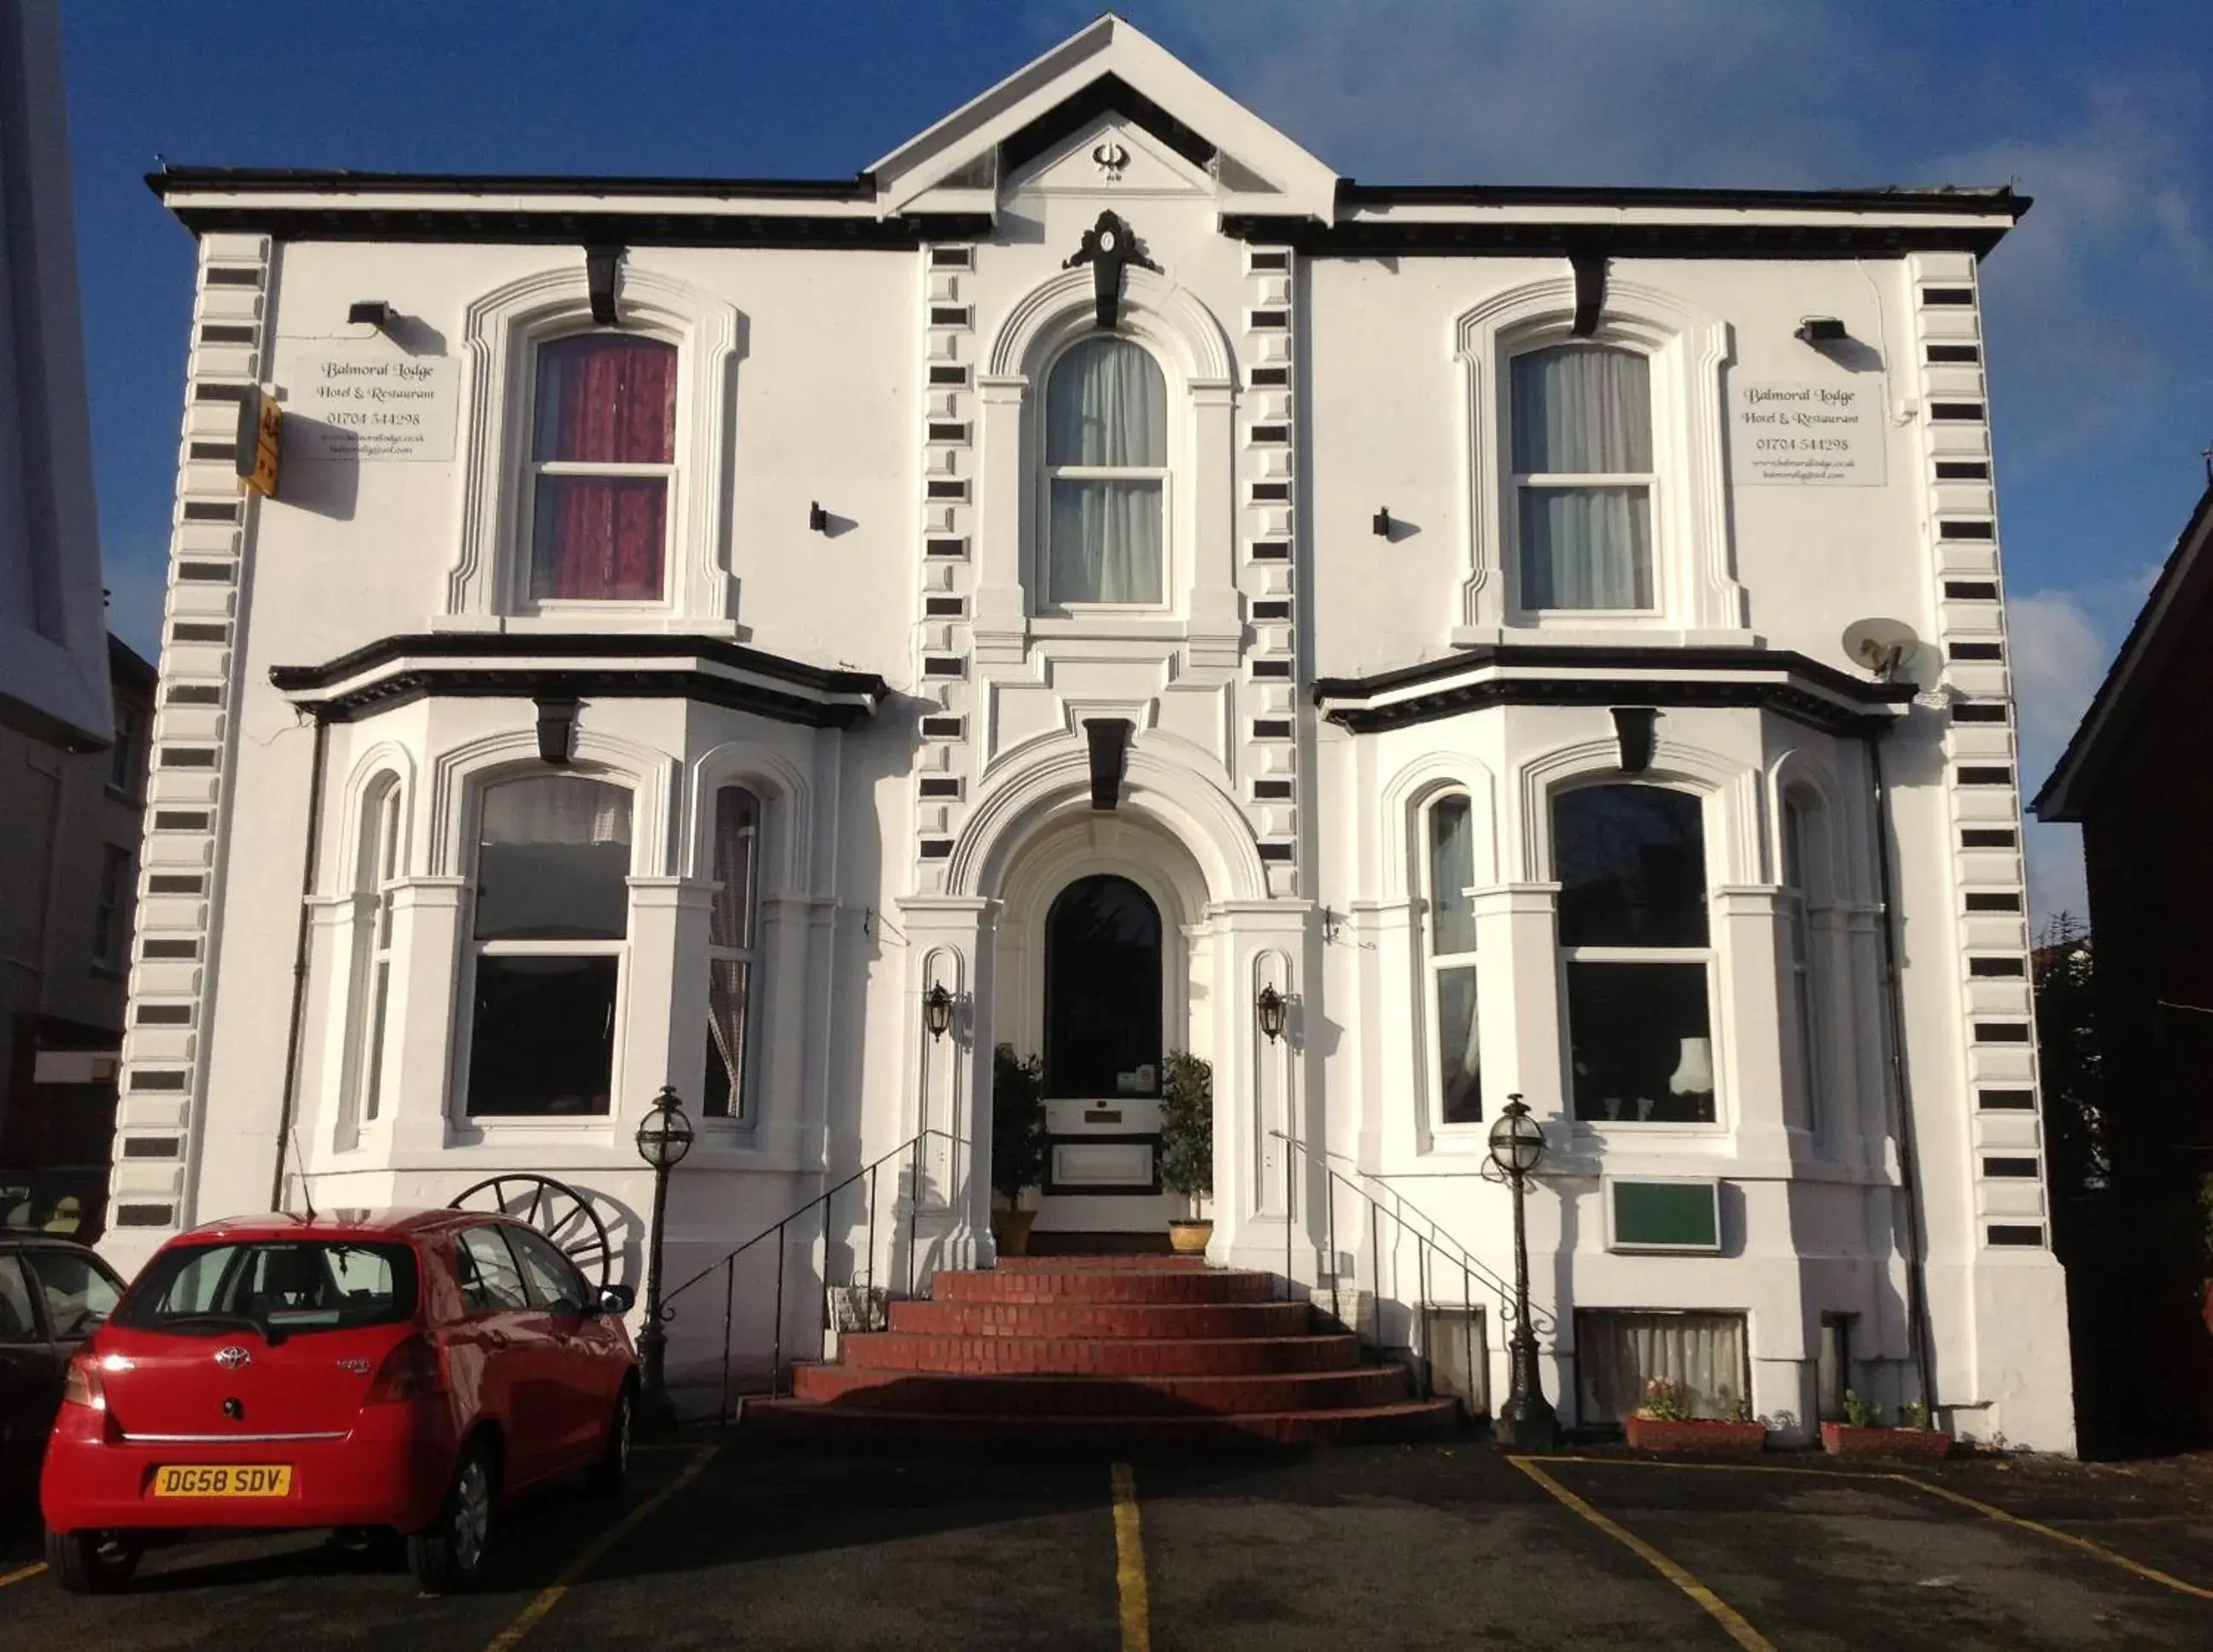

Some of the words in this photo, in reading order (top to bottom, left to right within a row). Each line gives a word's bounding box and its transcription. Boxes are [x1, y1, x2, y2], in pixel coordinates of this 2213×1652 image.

[321, 362, 389, 378] Balmoral
[393, 364, 434, 382] Lodge
[317, 386, 351, 399] Hotel
[354, 387, 365, 400] &
[368, 387, 435, 403] Restaurant
[1743, 388, 1810, 405] Balmoral
[1814, 388, 1856, 406] Lodge
[327, 412, 367, 425] 01704
[371, 413, 421, 426] 544298
[1743, 412, 1776, 424] Hotel
[1779, 412, 1790, 425] &
[1792, 412, 1859, 428] Restaurant
[1756, 438, 1796, 451] 01704
[1798, 438, 1848, 451] 544298
[165, 1469, 228, 1492] DG58
[235, 1469, 282, 1491] SDV
